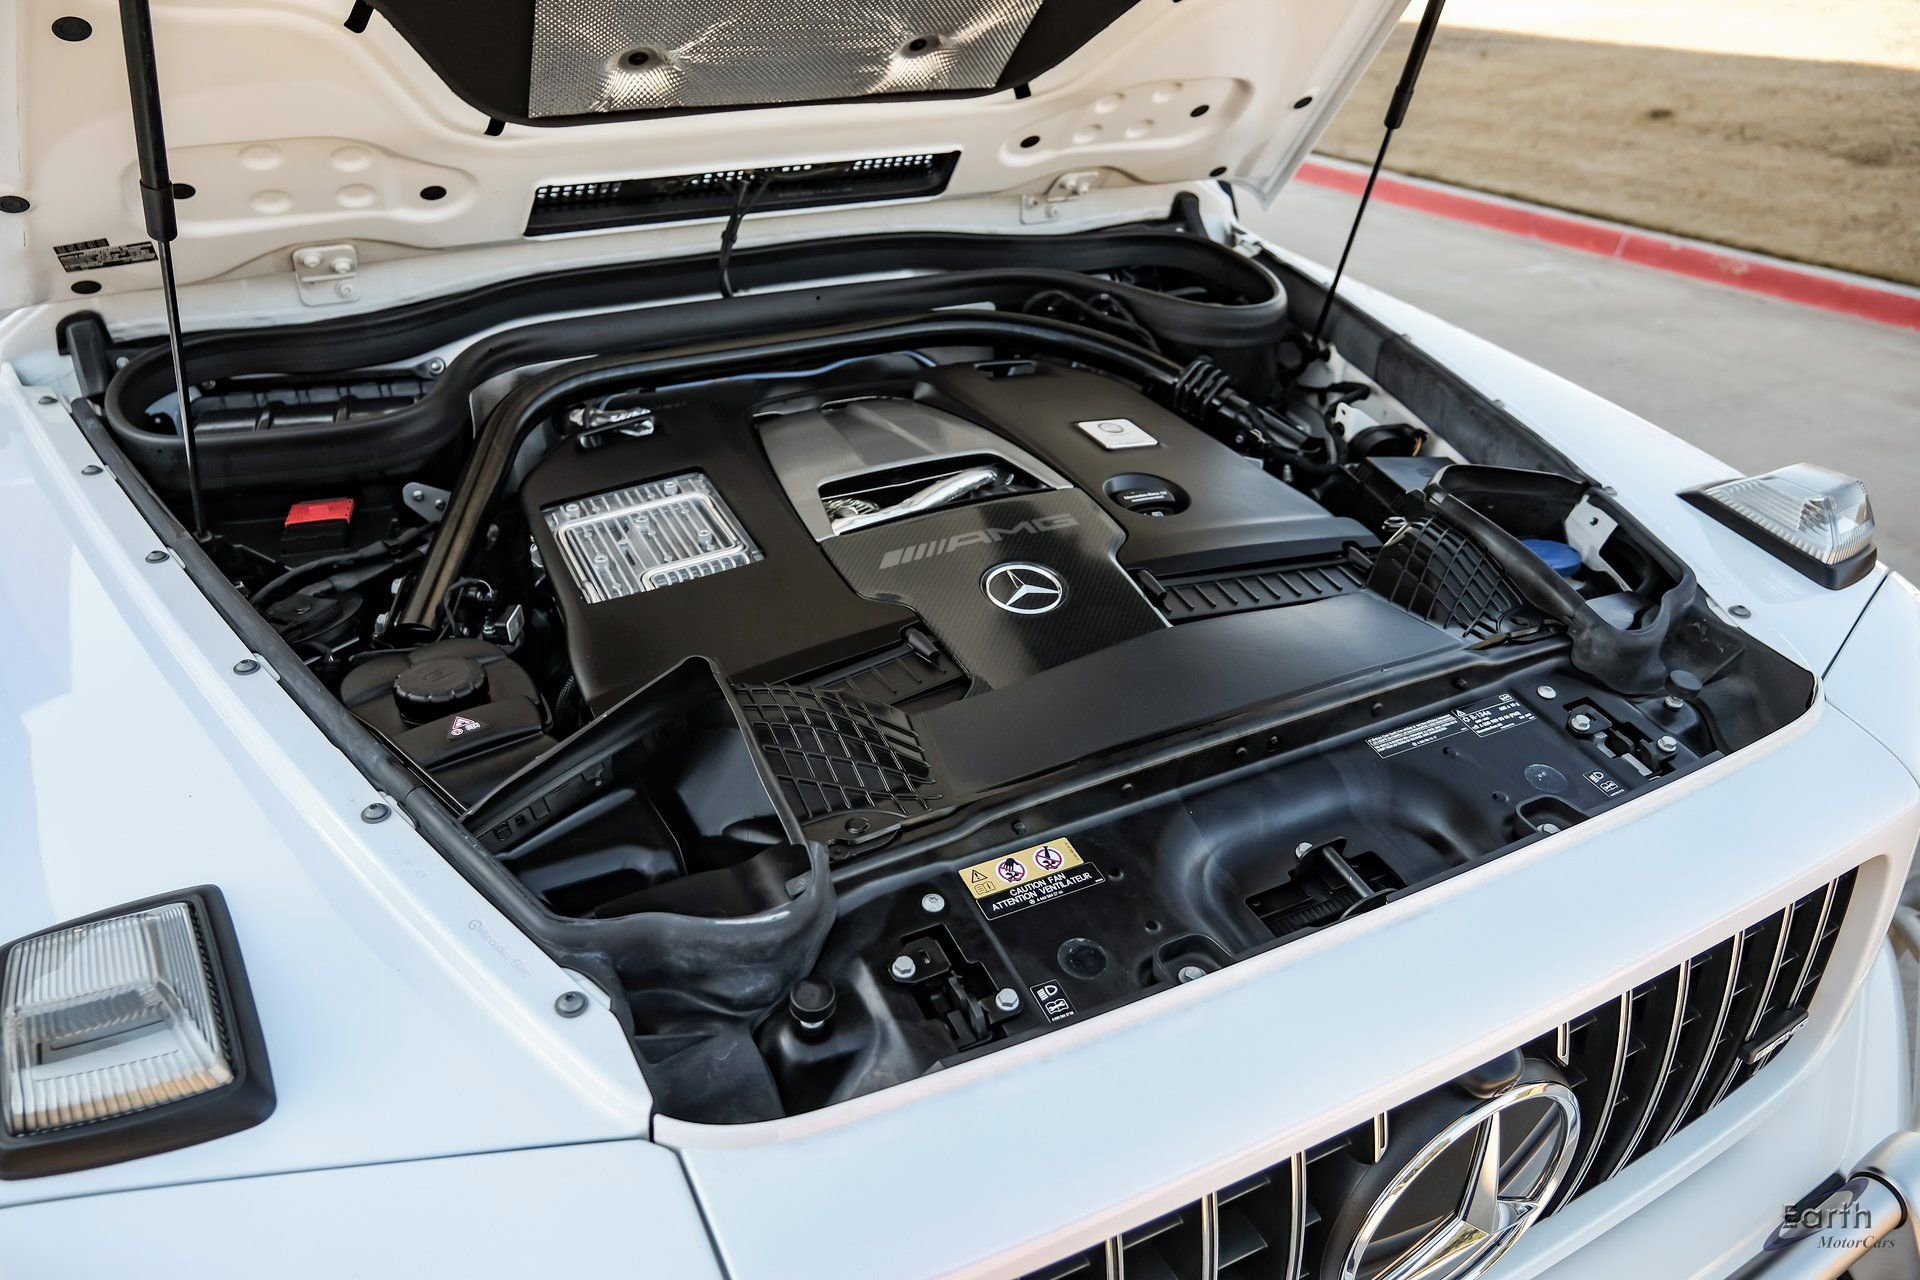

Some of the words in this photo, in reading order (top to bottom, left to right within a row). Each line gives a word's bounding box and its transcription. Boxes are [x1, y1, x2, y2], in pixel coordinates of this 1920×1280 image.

[946, 513, 1081, 553] AMG
[991, 890, 1038, 912] ATTENTION
[1040, 871, 1093, 897] VENTILATEUR
[1009, 876, 1047, 896] CAUTION
[1049, 872, 1067, 884] FAN
